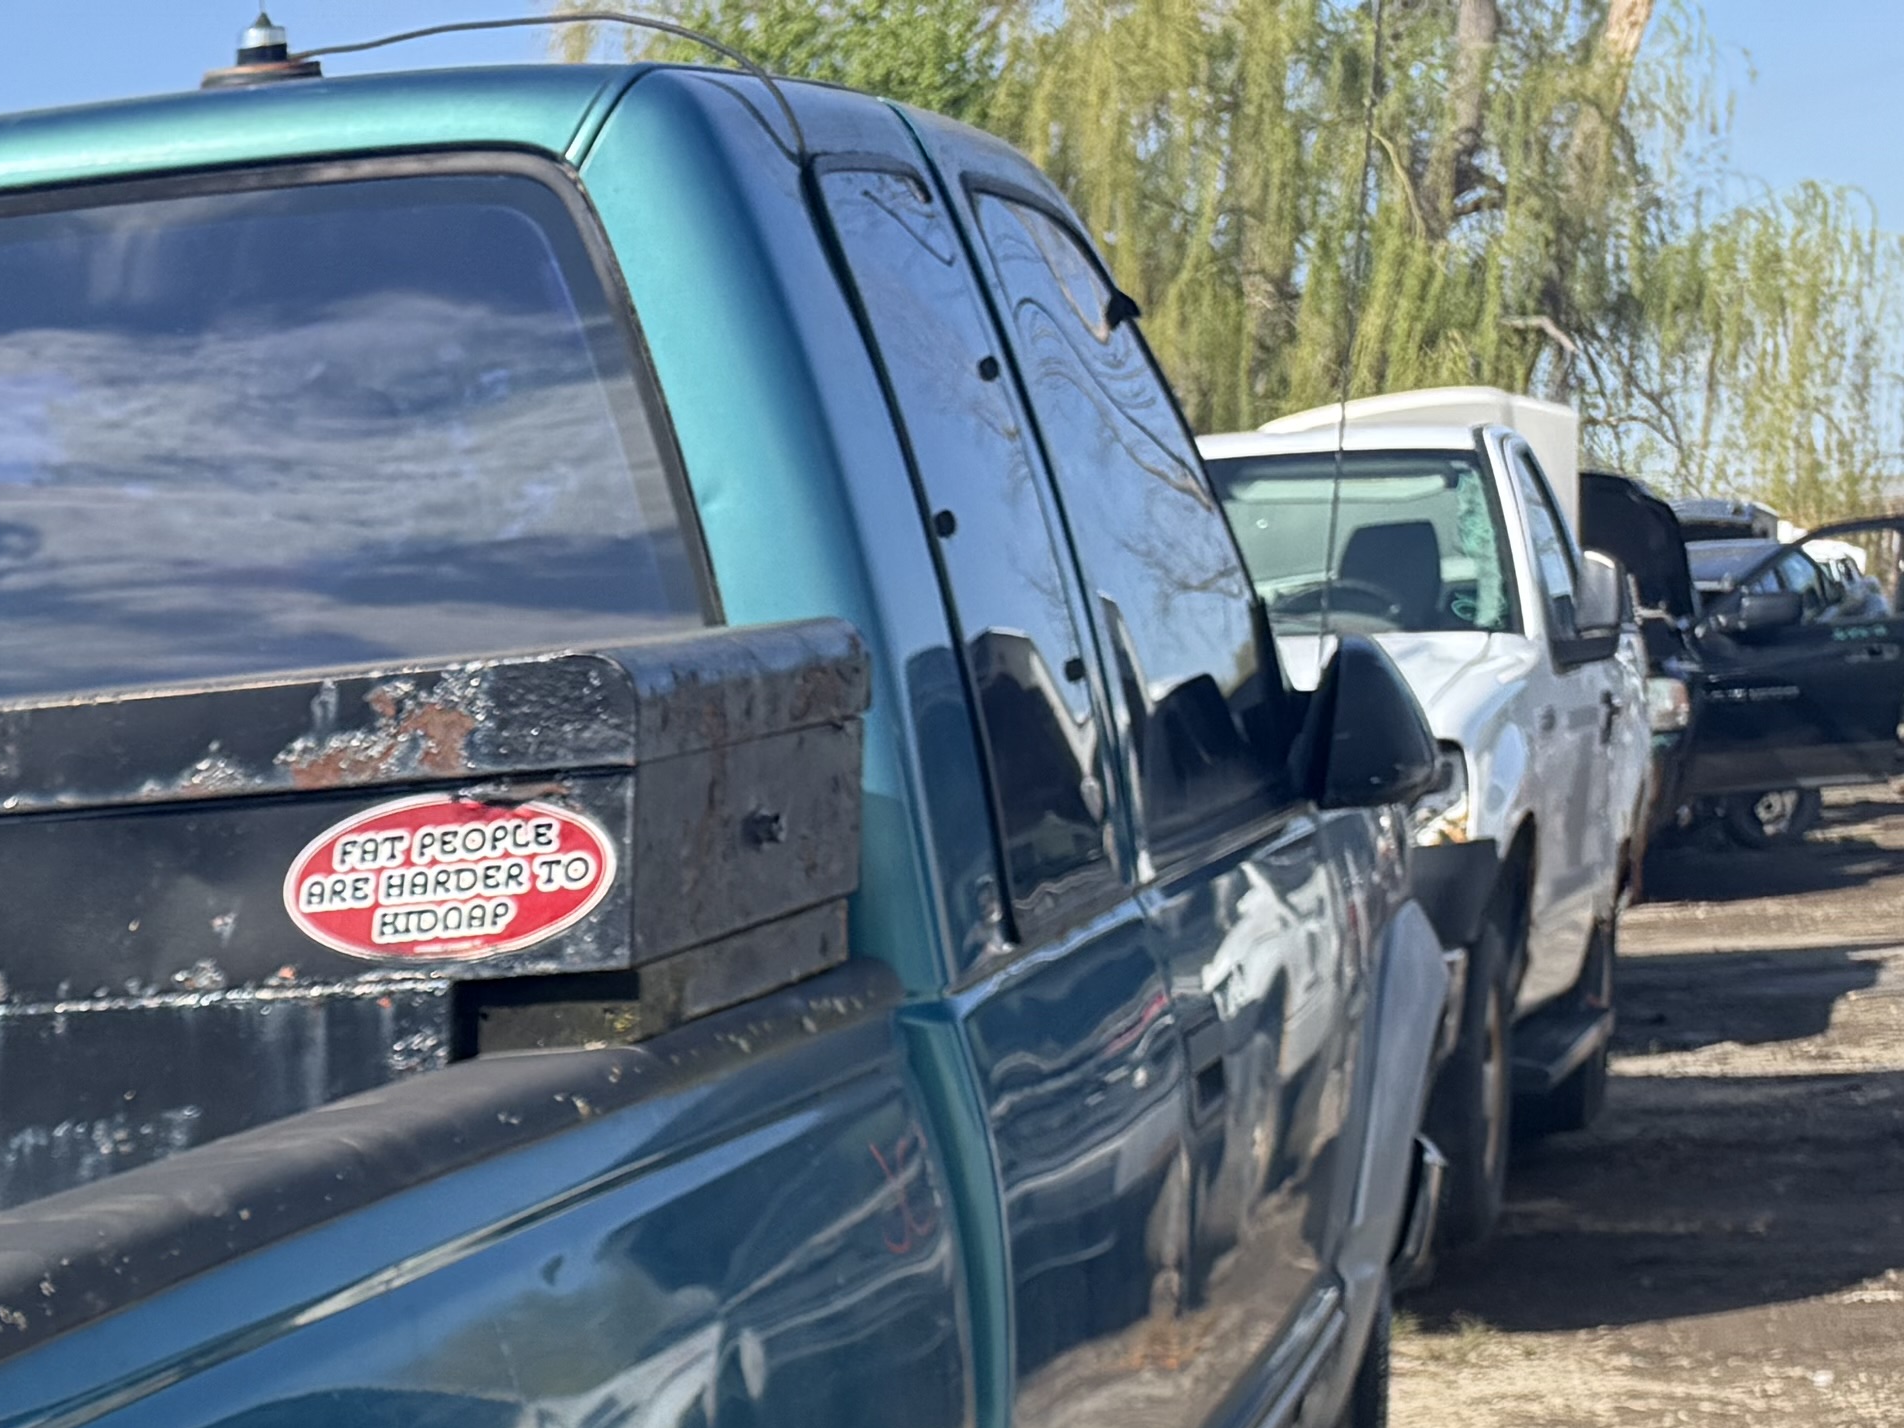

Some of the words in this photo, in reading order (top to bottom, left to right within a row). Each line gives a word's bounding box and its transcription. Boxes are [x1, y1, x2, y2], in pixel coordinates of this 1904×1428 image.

[338, 835, 404, 865] FAT
[418, 823, 554, 858] PEOPLE
[304, 876, 370, 906] ARE
[383, 862, 525, 899] HARDER
[538, 857, 590, 886] TO
[379, 902, 510, 936] KIDNAP
